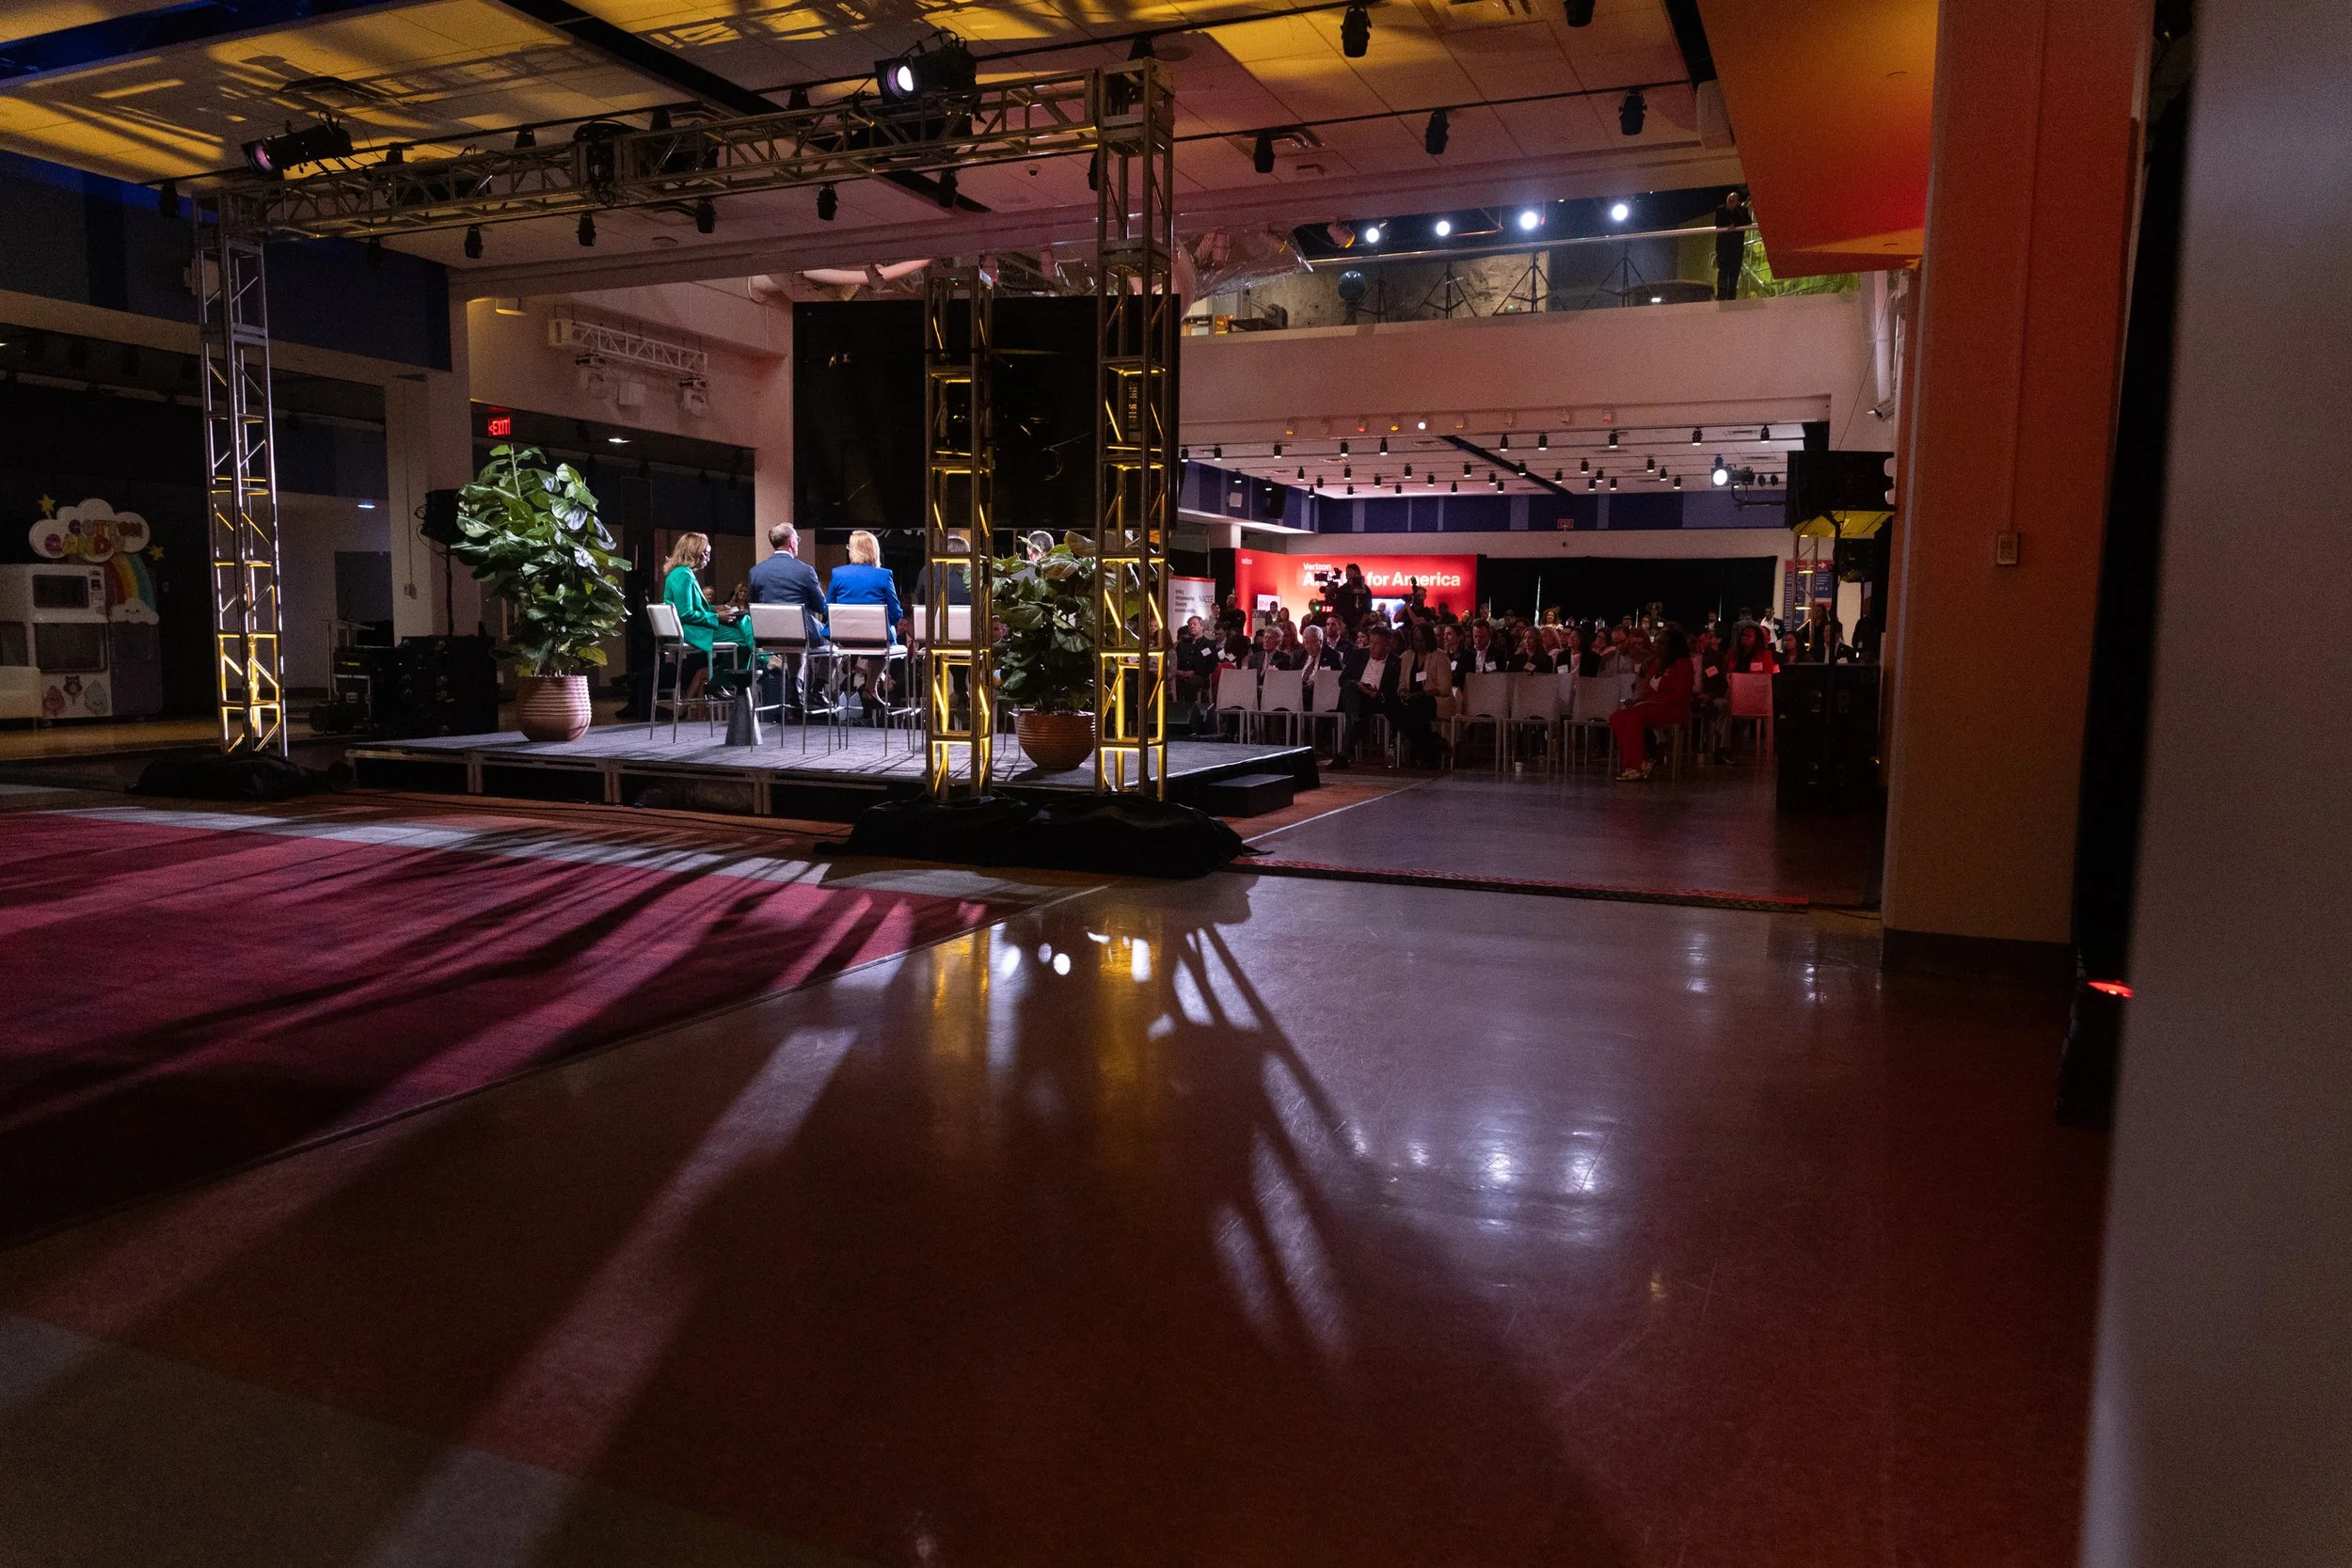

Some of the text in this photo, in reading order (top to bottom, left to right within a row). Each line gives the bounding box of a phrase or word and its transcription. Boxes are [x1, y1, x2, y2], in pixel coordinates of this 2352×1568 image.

[492, 420, 509, 436] EXIT
[1303, 562, 1331, 571] Verizon
[1367, 571, 1389, 586] for
[1391, 571, 1461, 587] America
